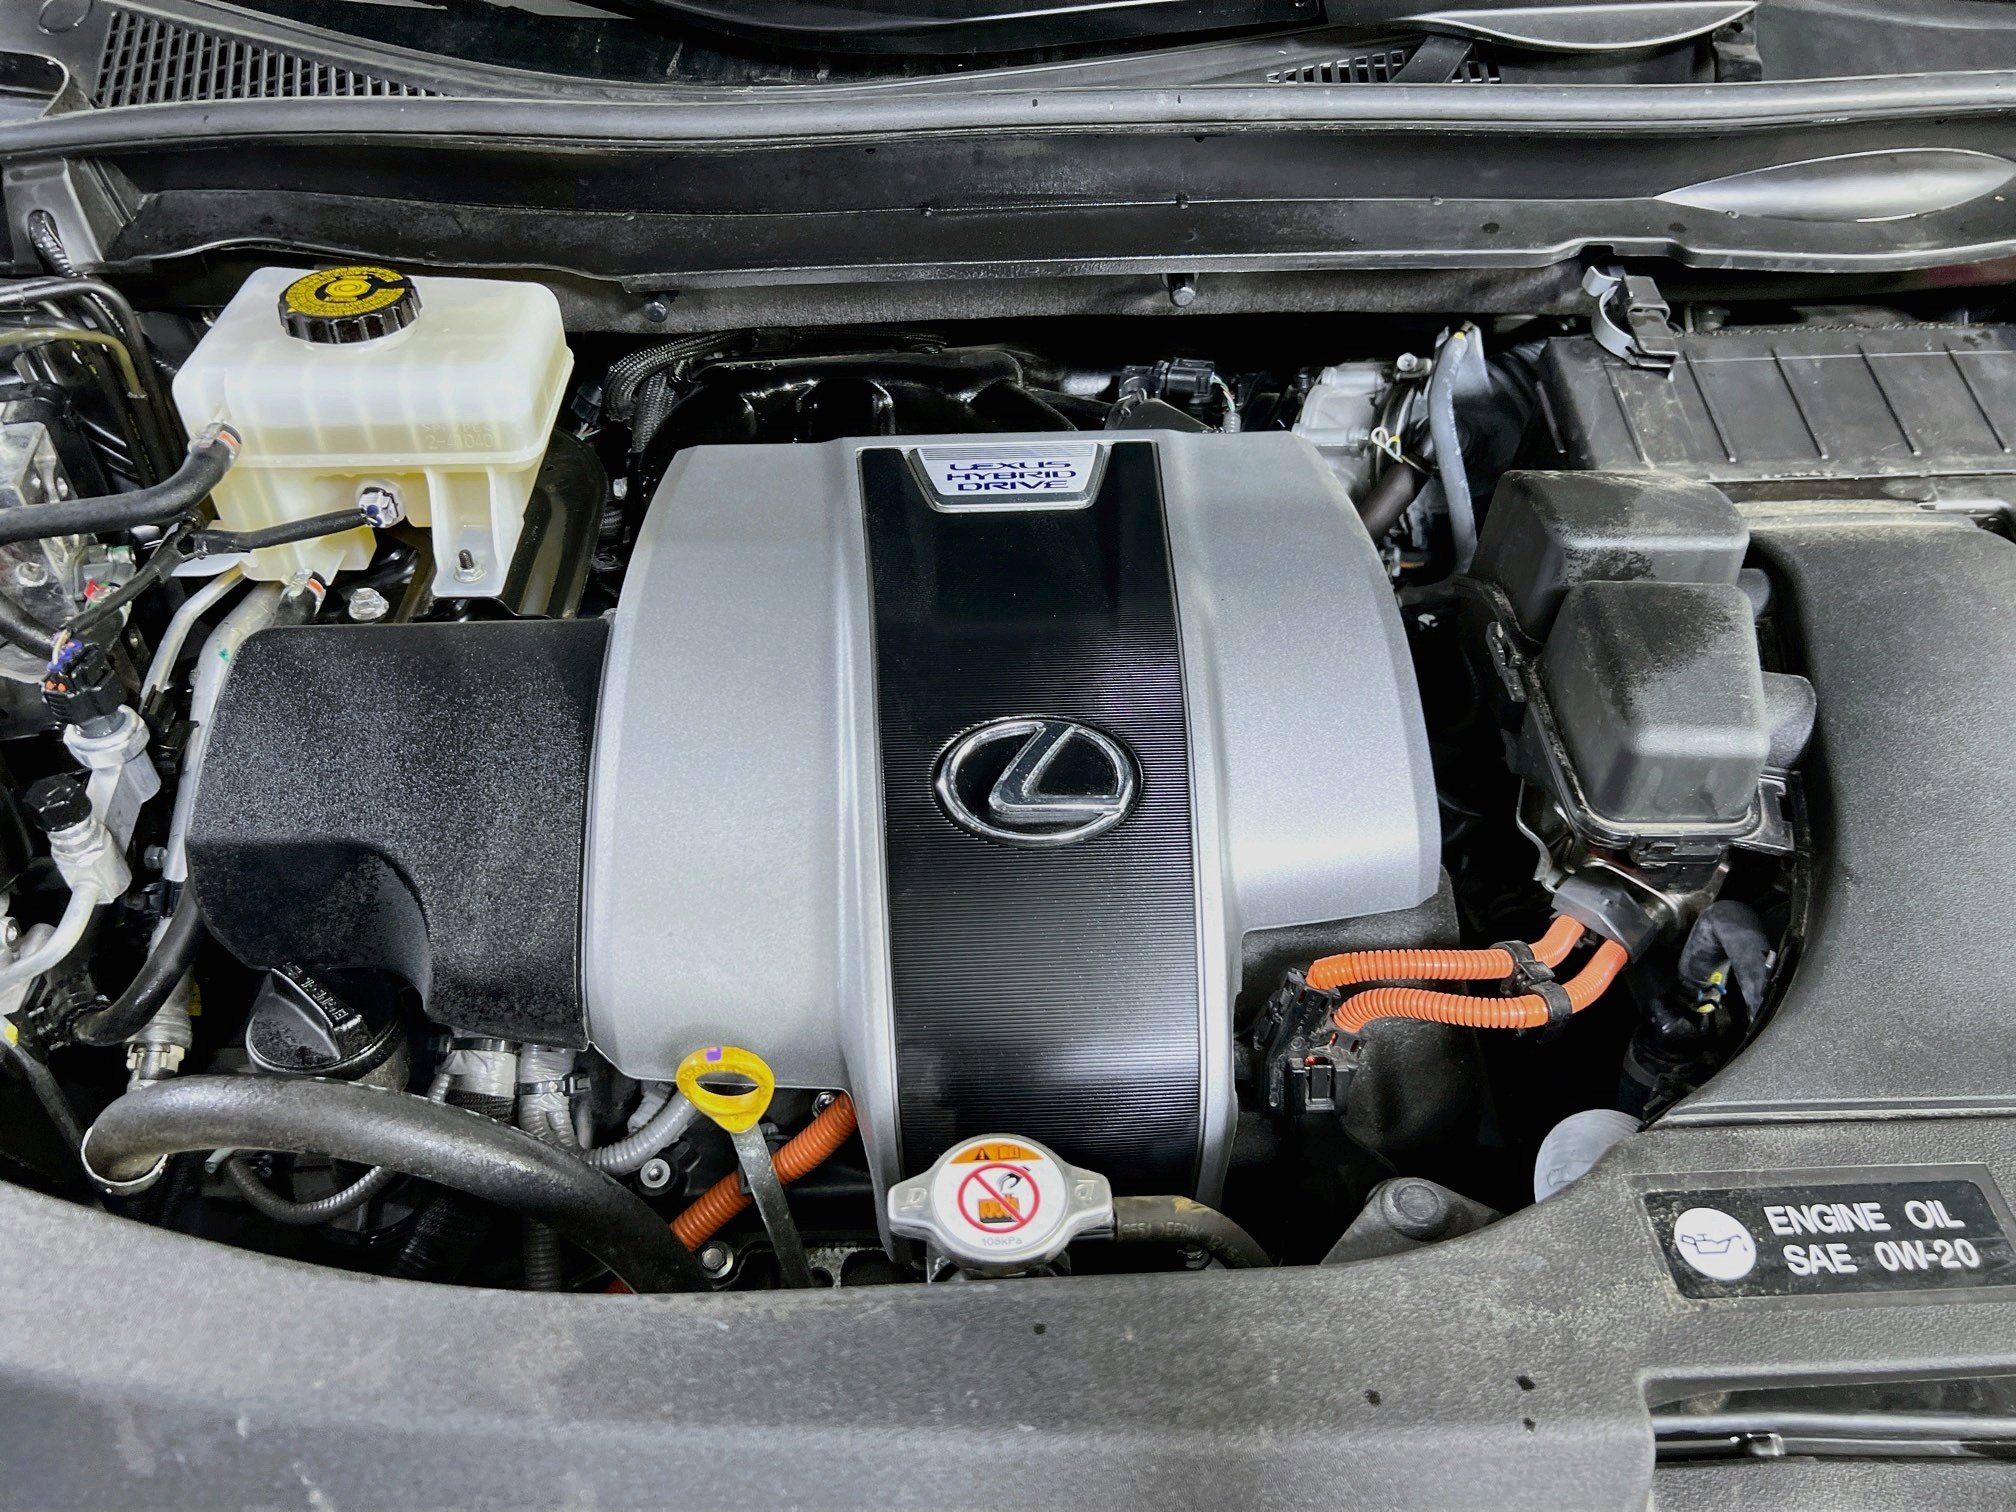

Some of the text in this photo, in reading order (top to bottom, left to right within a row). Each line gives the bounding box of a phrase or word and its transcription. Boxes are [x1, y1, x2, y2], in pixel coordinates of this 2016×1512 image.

[949, 461, 1072, 471] LEXUS
[946, 471, 1077, 481] HYBRID
[957, 480, 1069, 491] DRIVE
[1763, 1199, 1966, 1236] ENGINE OIL
[1782, 1238, 1982, 1276] SAE 0W-20
